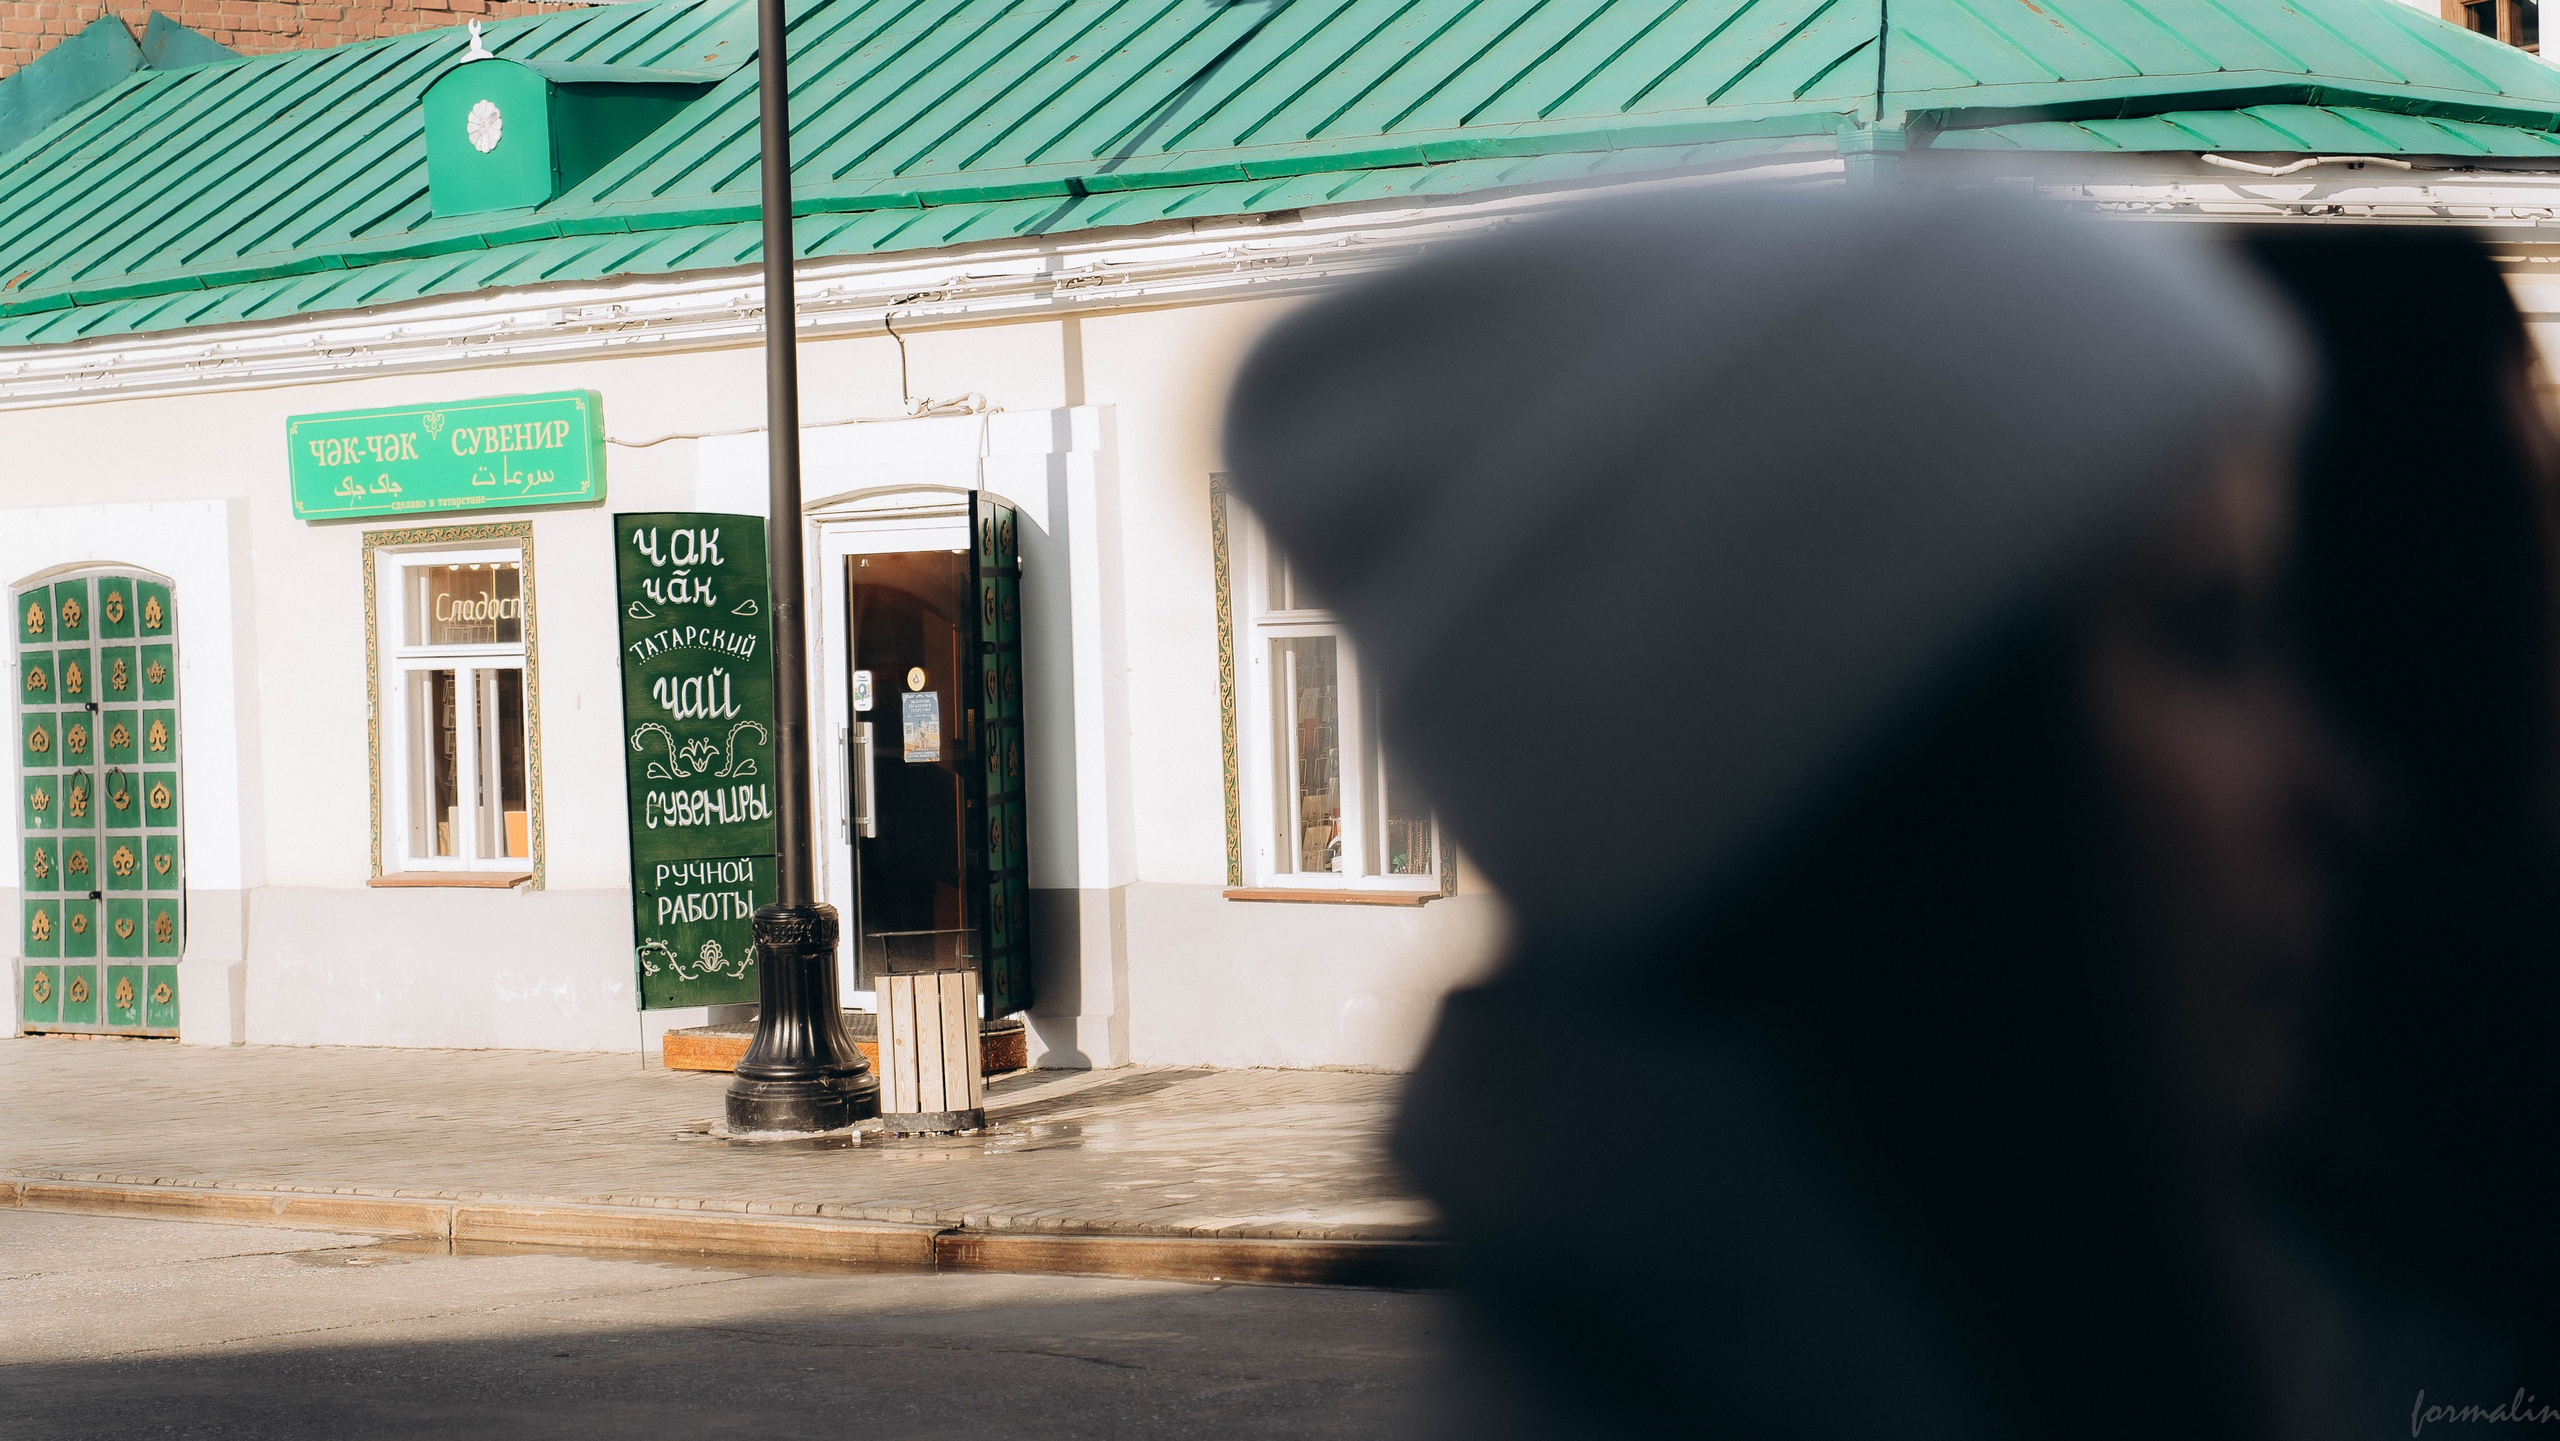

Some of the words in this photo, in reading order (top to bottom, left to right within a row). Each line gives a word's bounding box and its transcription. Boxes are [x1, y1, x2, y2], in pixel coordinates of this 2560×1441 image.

[451, 420, 569, 457] СУВЕНИР
[391, 500, 426, 511] сделано
[429, 499, 435, 508] в
[437, 495, 486, 508] татарстане
[629, 625, 756, 660] ТАТАРСКИЙ
[656, 857, 754, 887] РУЧНОЙ
[658, 889, 754, 926] РАБОТЫ
